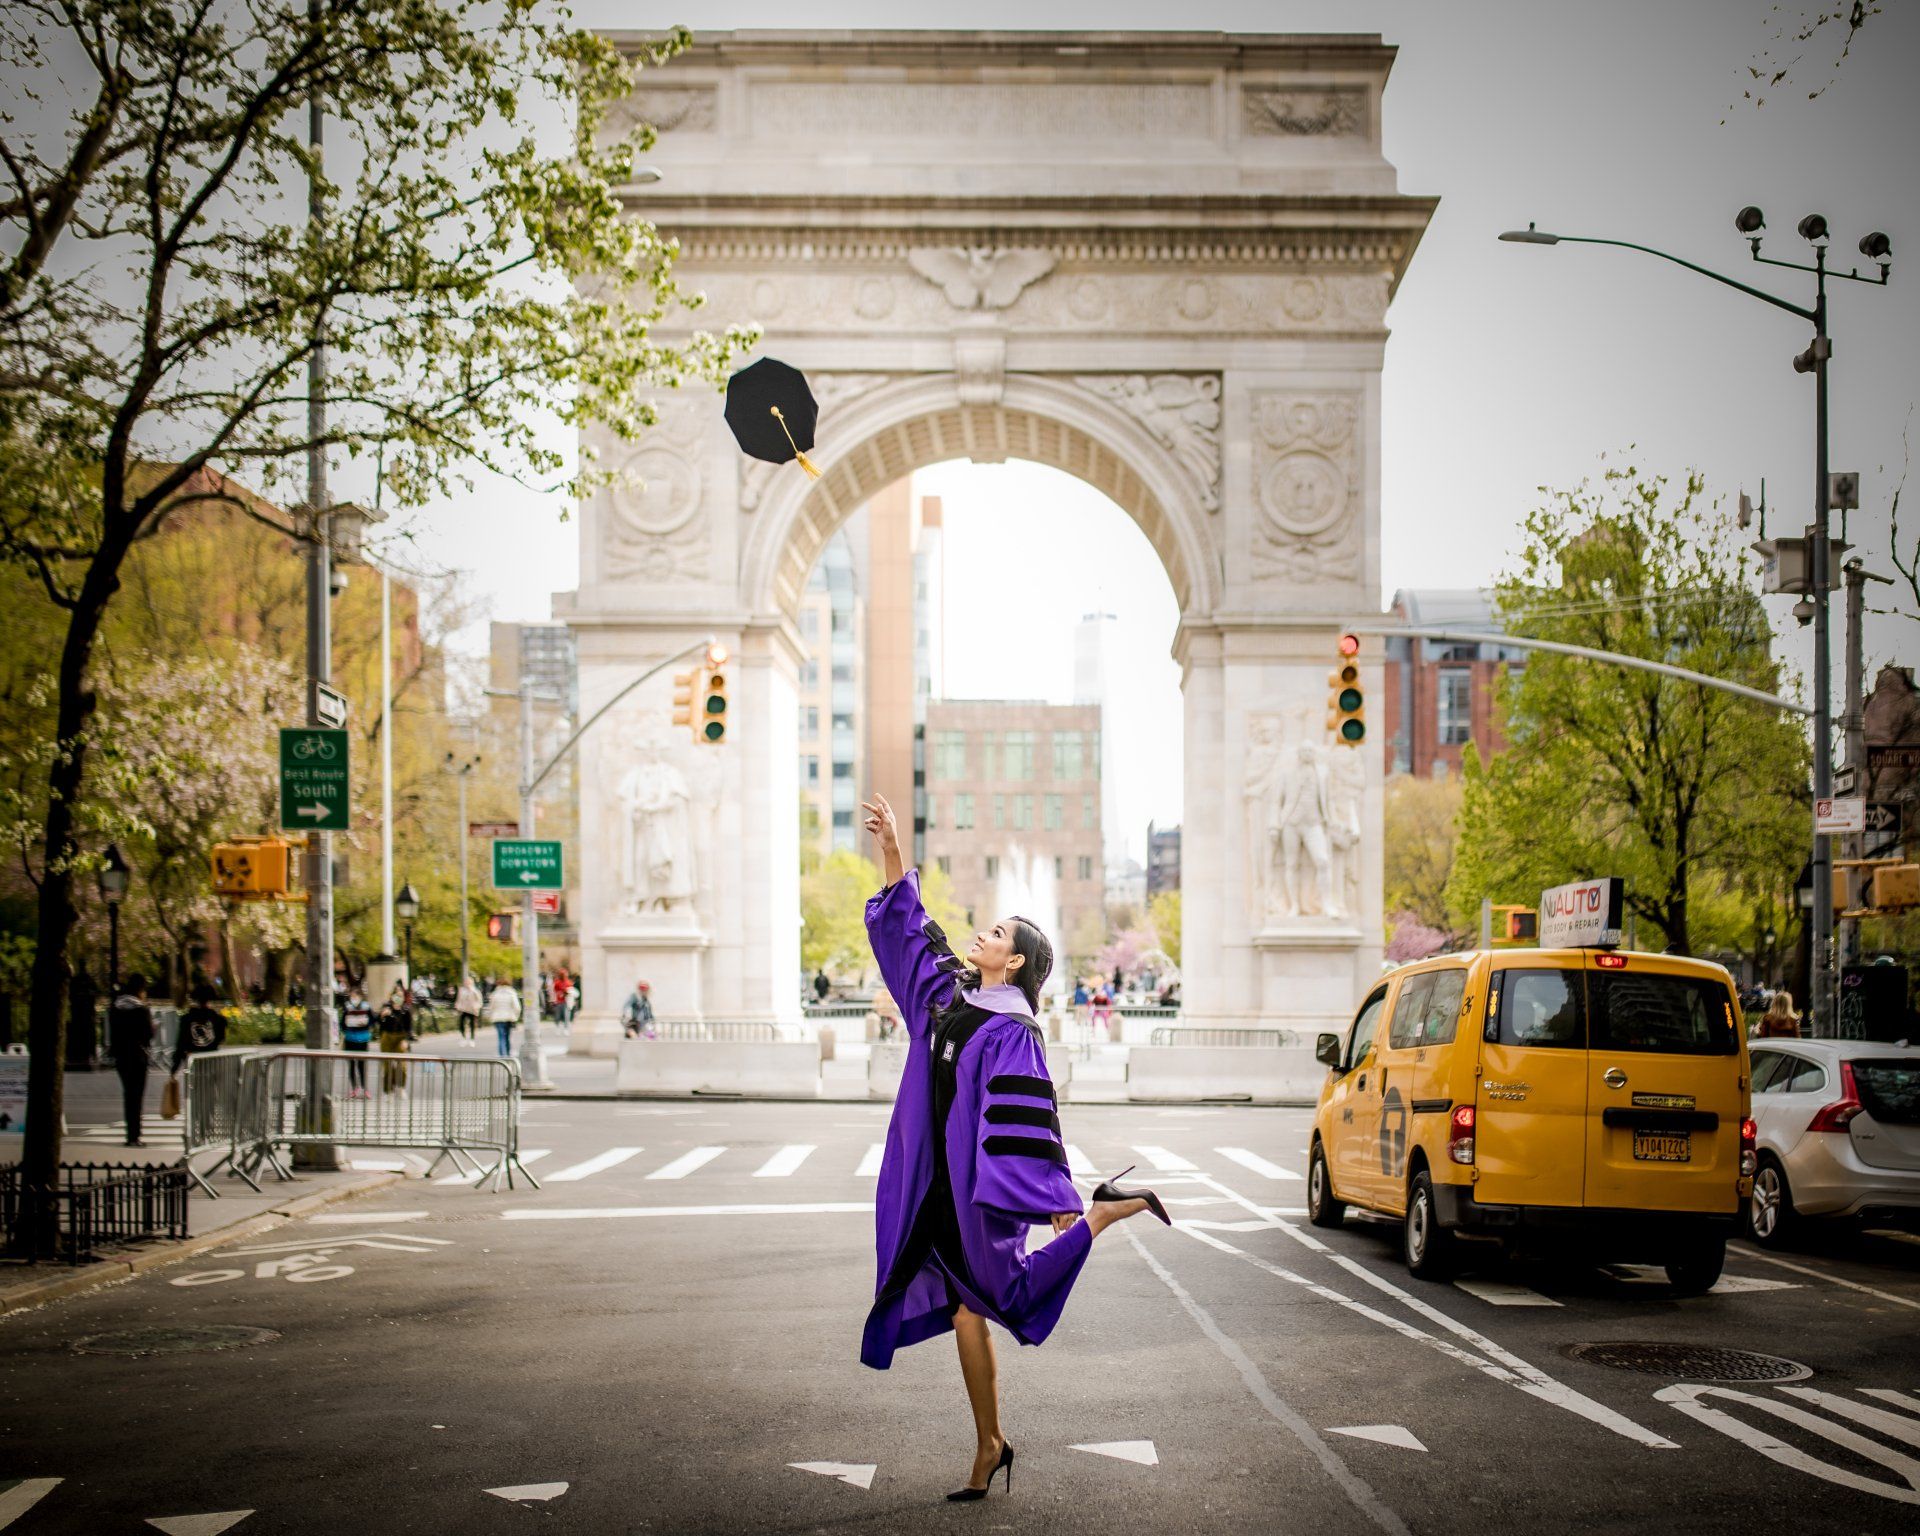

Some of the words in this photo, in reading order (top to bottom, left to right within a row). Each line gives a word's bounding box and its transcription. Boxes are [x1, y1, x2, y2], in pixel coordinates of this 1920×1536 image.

[284, 769, 308, 781] Best
[312, 769, 345, 781] Route
[293, 784, 337, 798] South
[501, 846, 554, 855] BROADWAY
[501, 859, 556, 868] DOWNTOWN
[1575, 918, 1600, 930] REPAIR
